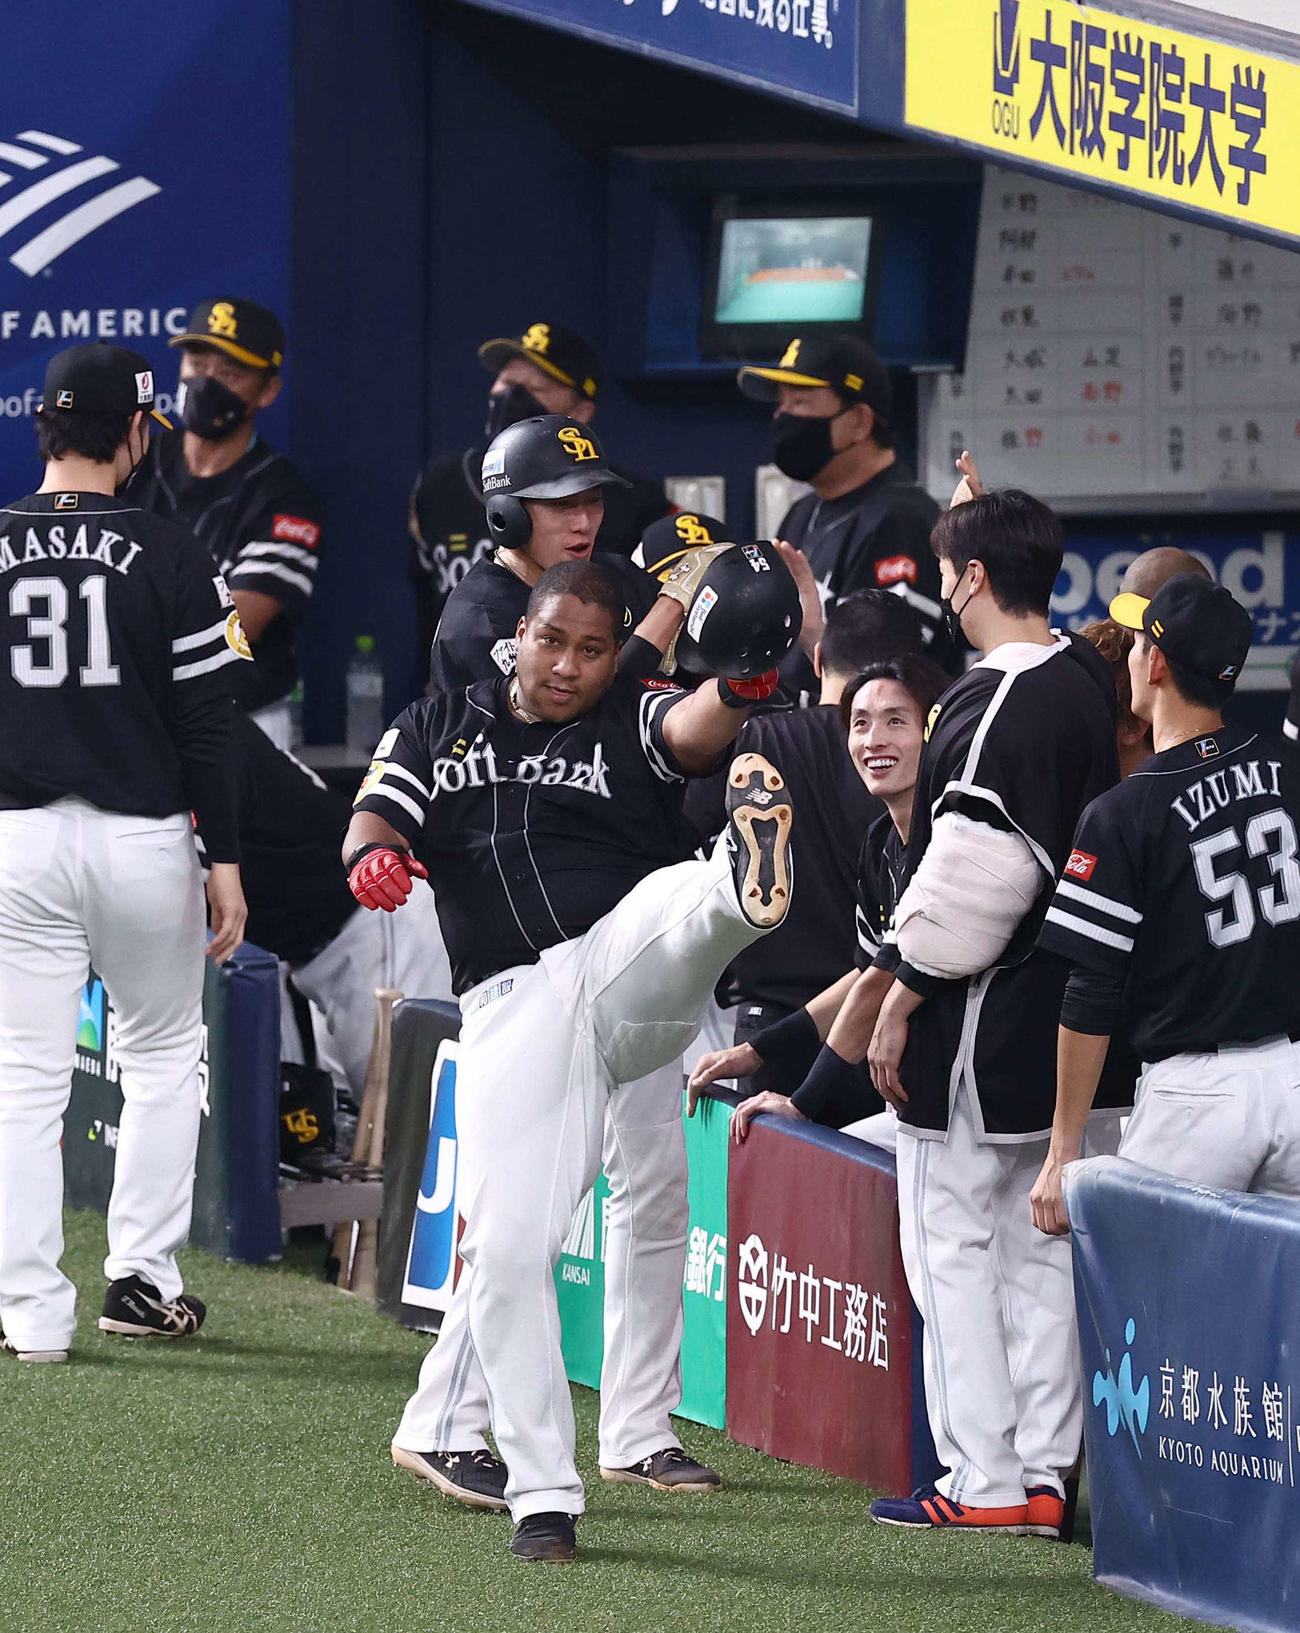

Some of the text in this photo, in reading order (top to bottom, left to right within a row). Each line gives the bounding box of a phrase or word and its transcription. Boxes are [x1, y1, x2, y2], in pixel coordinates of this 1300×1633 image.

[992, 98, 1020, 140] OGU
[1029, 9, 1268, 206] 大阪学院大学
[482, 475, 512, 493] SoftBank
[9, 574, 121, 688] 31
[1170, 760, 1282, 833] IZUMI
[1189, 807, 1300, 949] 53
[562, 1262, 591, 1286] KANSAI
[771, 1252, 889, 1372] 竹中工務店
[1159, 1357, 1284, 1442] 京都水族館
[1159, 1436, 1204, 1467] KYOTO
